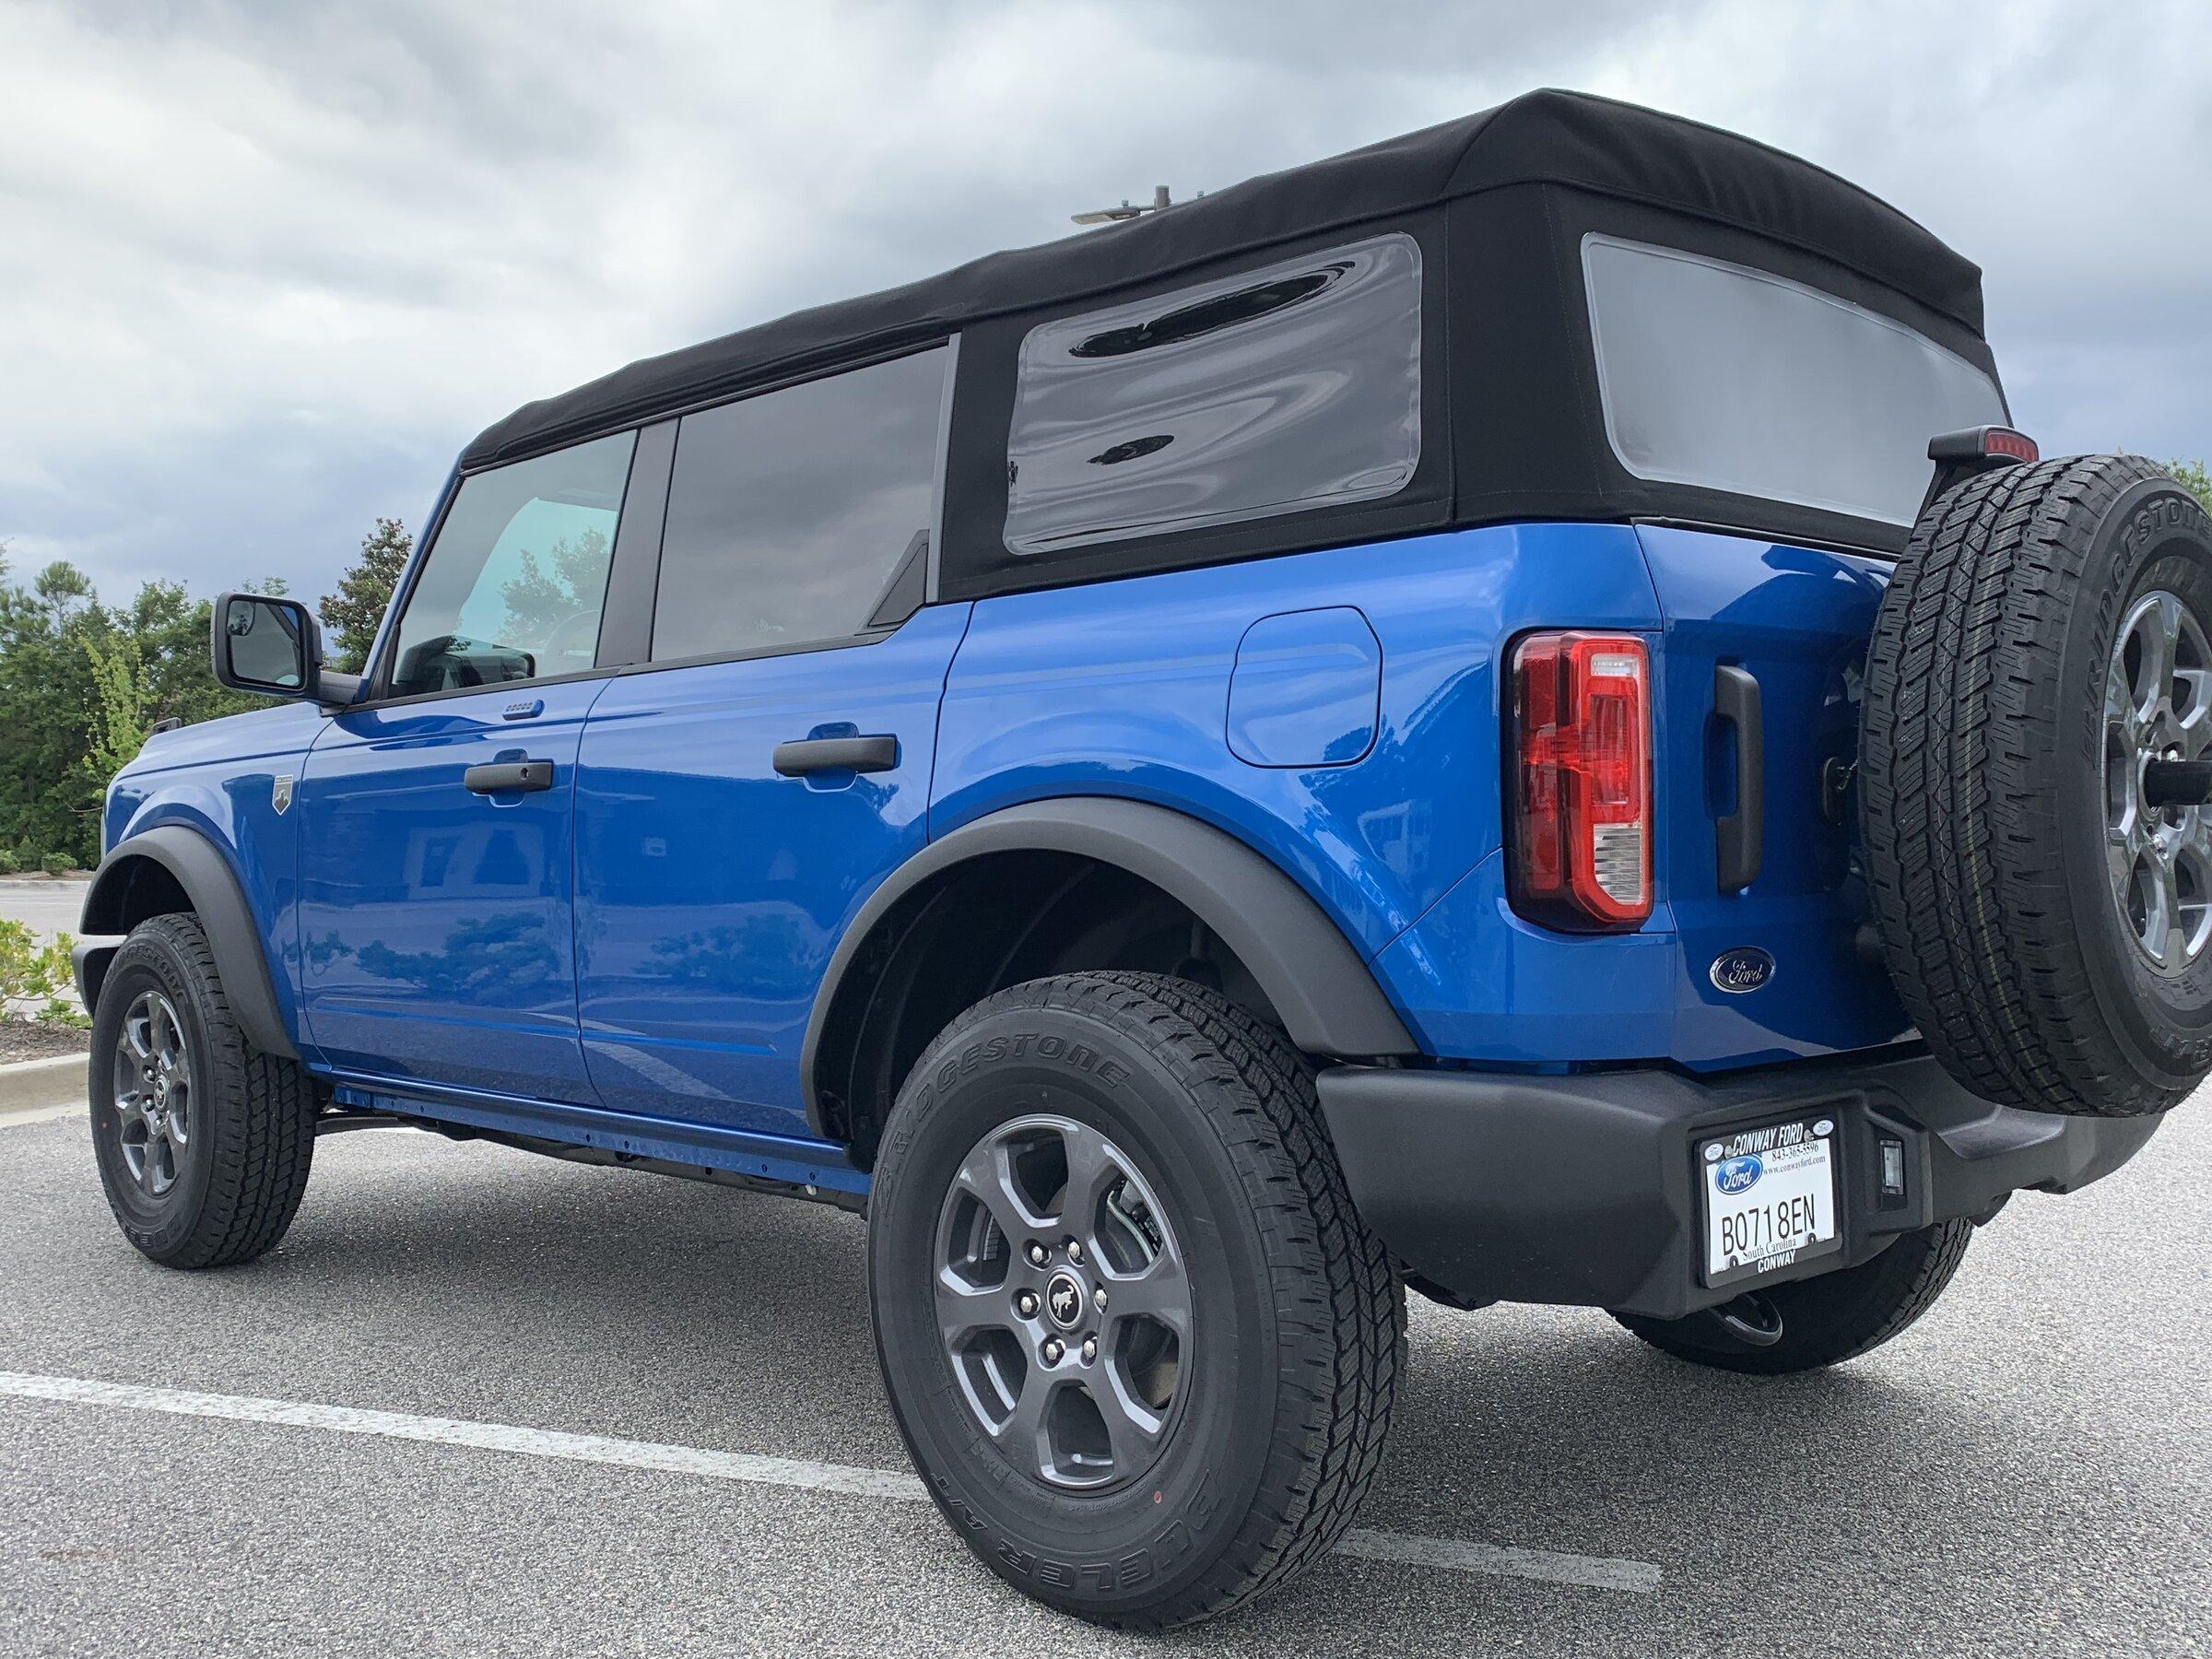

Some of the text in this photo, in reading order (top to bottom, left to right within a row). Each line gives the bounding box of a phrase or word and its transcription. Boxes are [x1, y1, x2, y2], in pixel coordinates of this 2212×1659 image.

[1731, 1122, 1804, 1158] CONWAY FORD
[1763, 1156, 1827, 1175] www.conwayford.com
[1742, 1244, 1765, 1262] South
[1765, 1237, 1797, 1255] Carolina
[1757, 1249, 1796, 1274] CONWAY
